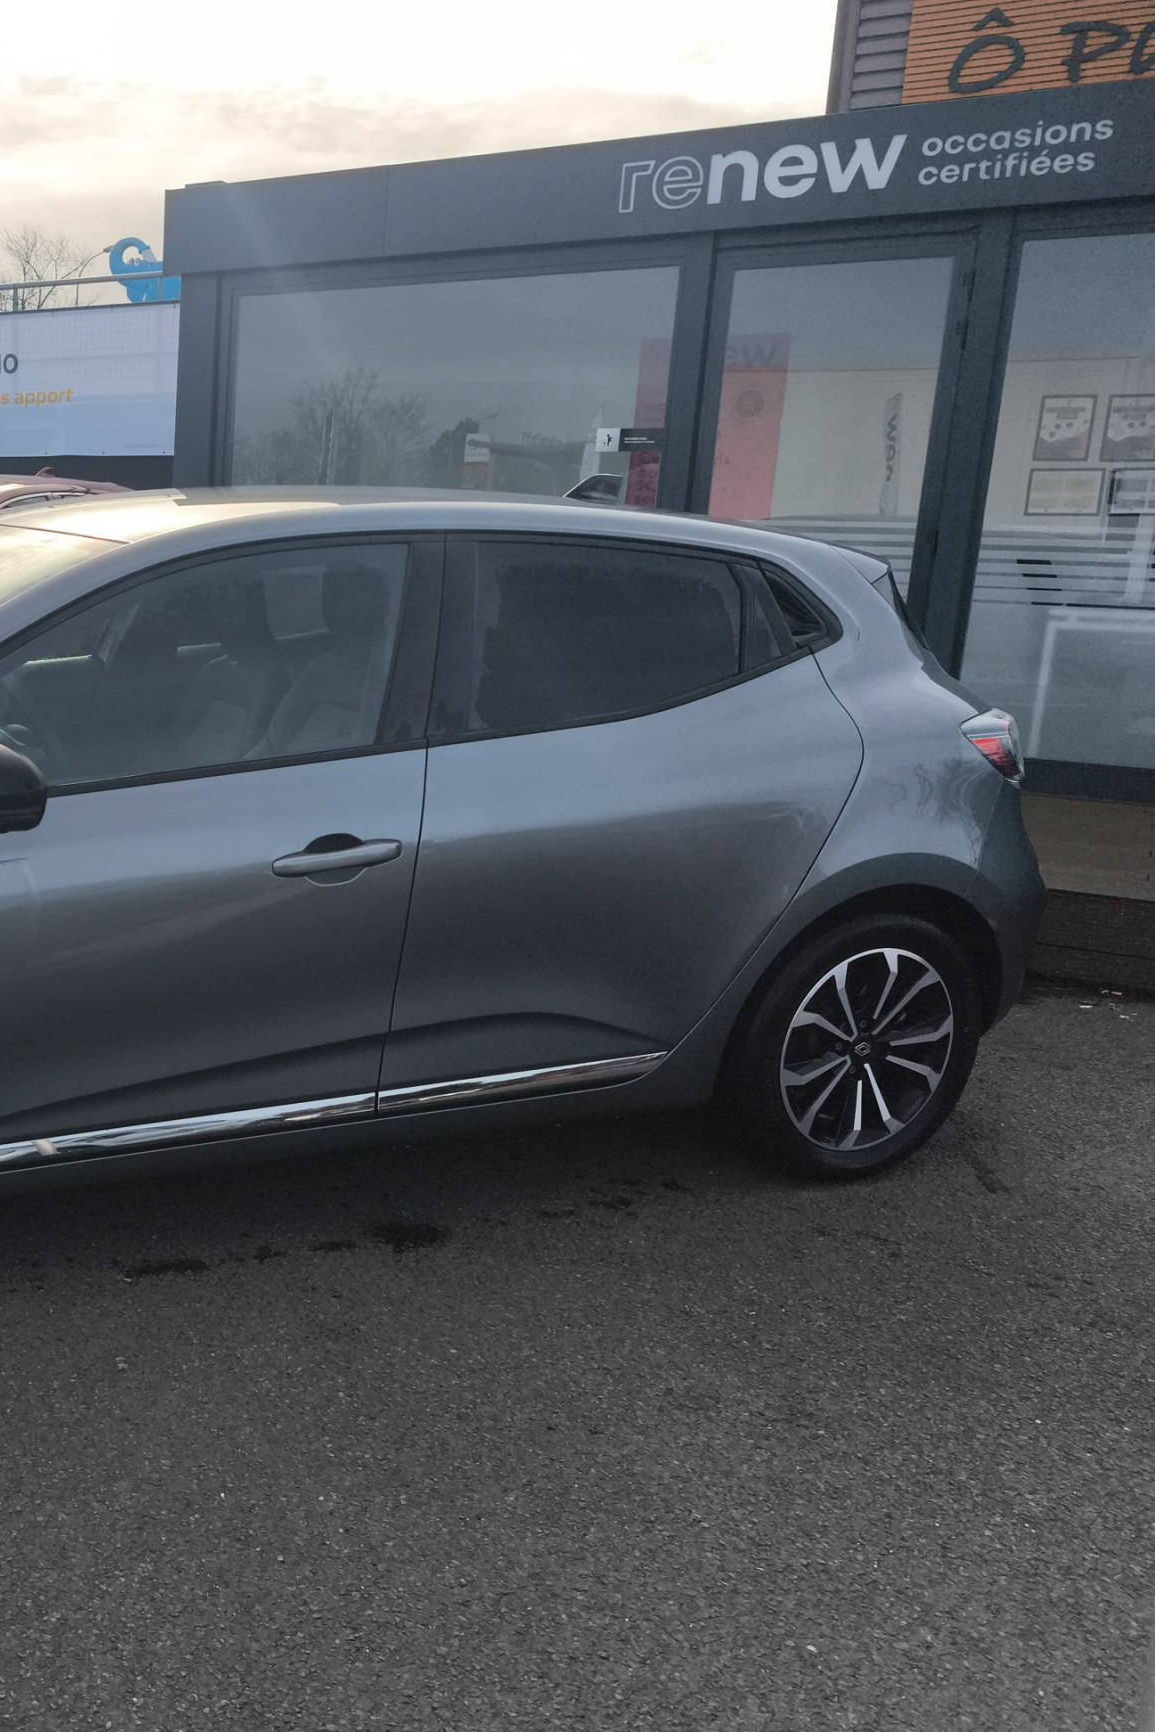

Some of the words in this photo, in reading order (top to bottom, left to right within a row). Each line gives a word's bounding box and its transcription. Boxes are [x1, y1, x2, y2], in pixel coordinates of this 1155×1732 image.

[921, 118, 1115, 157] occasions
[619, 134, 908, 213] renew
[917, 148, 1096, 186] certifiées
[14, 387, 74, 408] apport
